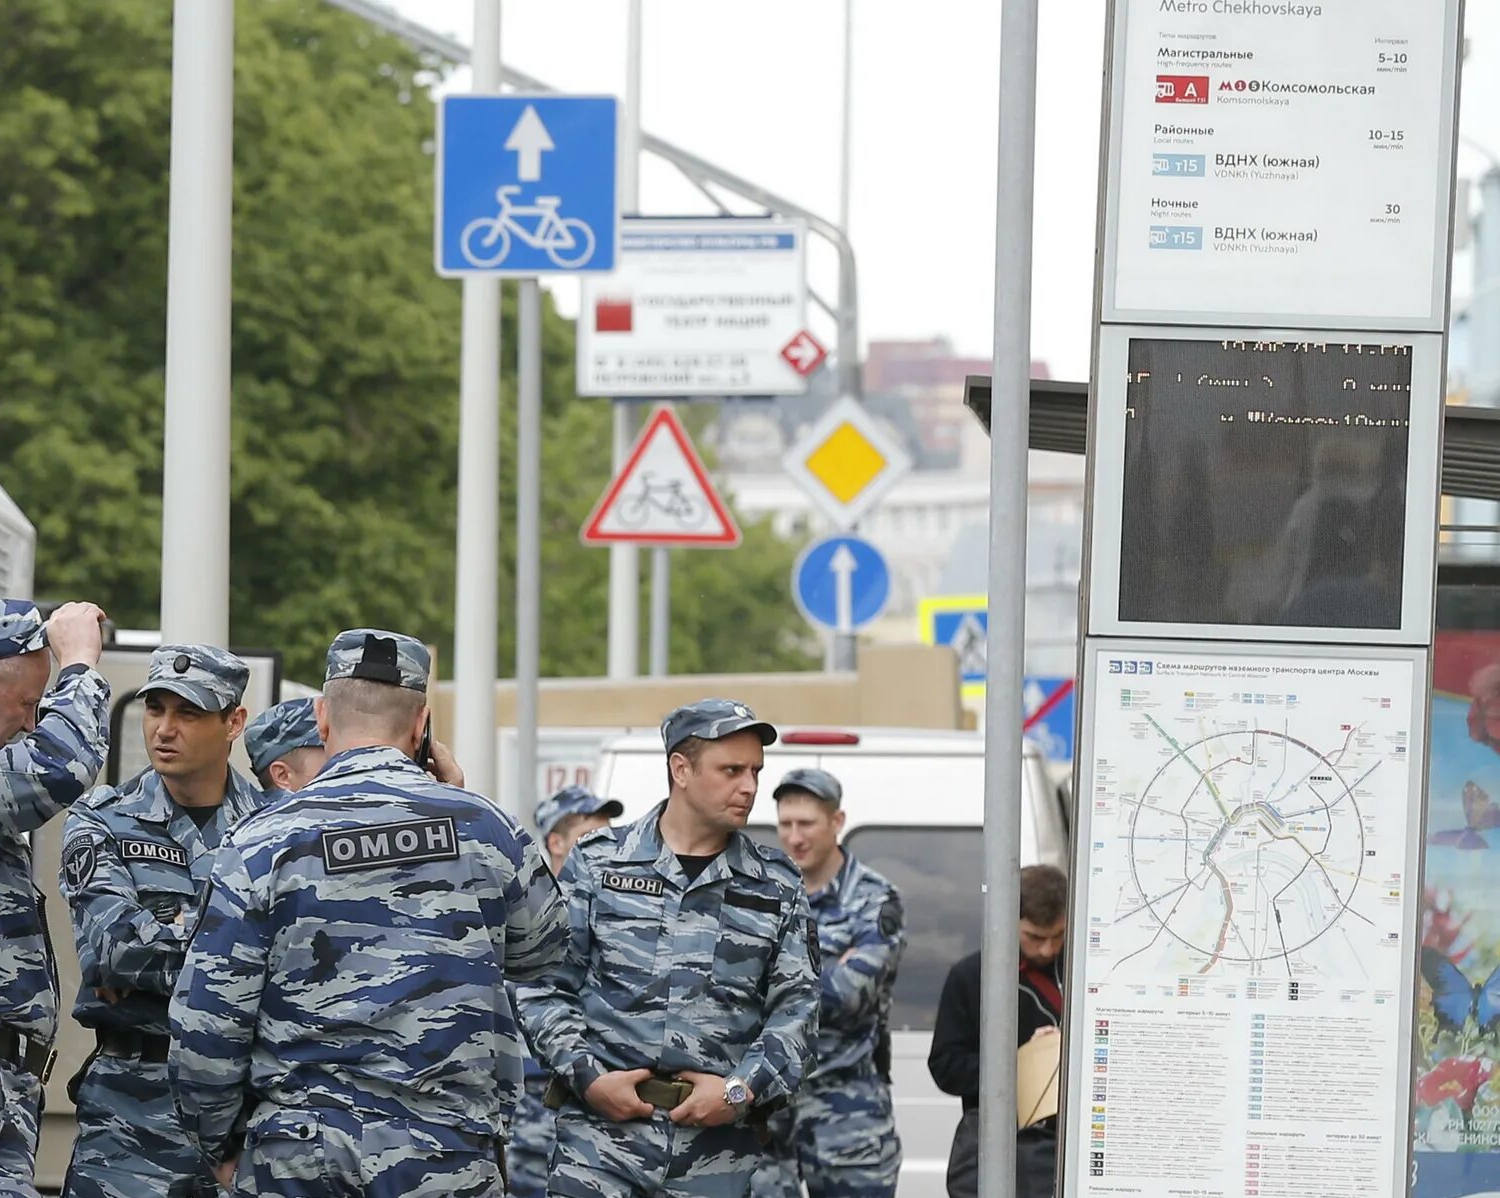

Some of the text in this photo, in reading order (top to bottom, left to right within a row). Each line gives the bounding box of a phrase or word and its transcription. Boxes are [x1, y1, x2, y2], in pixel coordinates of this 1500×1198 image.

[1159, 0, 1323, 18] Metro Chekhovskaya
[1157, 47, 1254, 60] Магистральные
[1261, 80, 1375, 96] Комсомольская
[1216, 95, 1290, 106] Komsomolskaya
[1154, 124, 1215, 136] Районные
[1215, 154, 1320, 169] ВДНХ (южная)
[1214, 169, 1299, 181] VDNKh (Yuzhnaya)
[1151, 198, 1199, 209] Ночные
[1385, 204, 1401, 215] 30
[1214, 227, 1318, 242] ВДНХ (южная)
[1213, 243, 1299, 255] VDNKh (Yuzhnaya)
[1156, 661, 1380, 677] Схема маршрутов наземного транспорта центра Москвы
[330, 824, 450, 863] ОМОН
[129, 842, 181, 862] ОМОН
[609, 874, 659, 893] ОМОН
